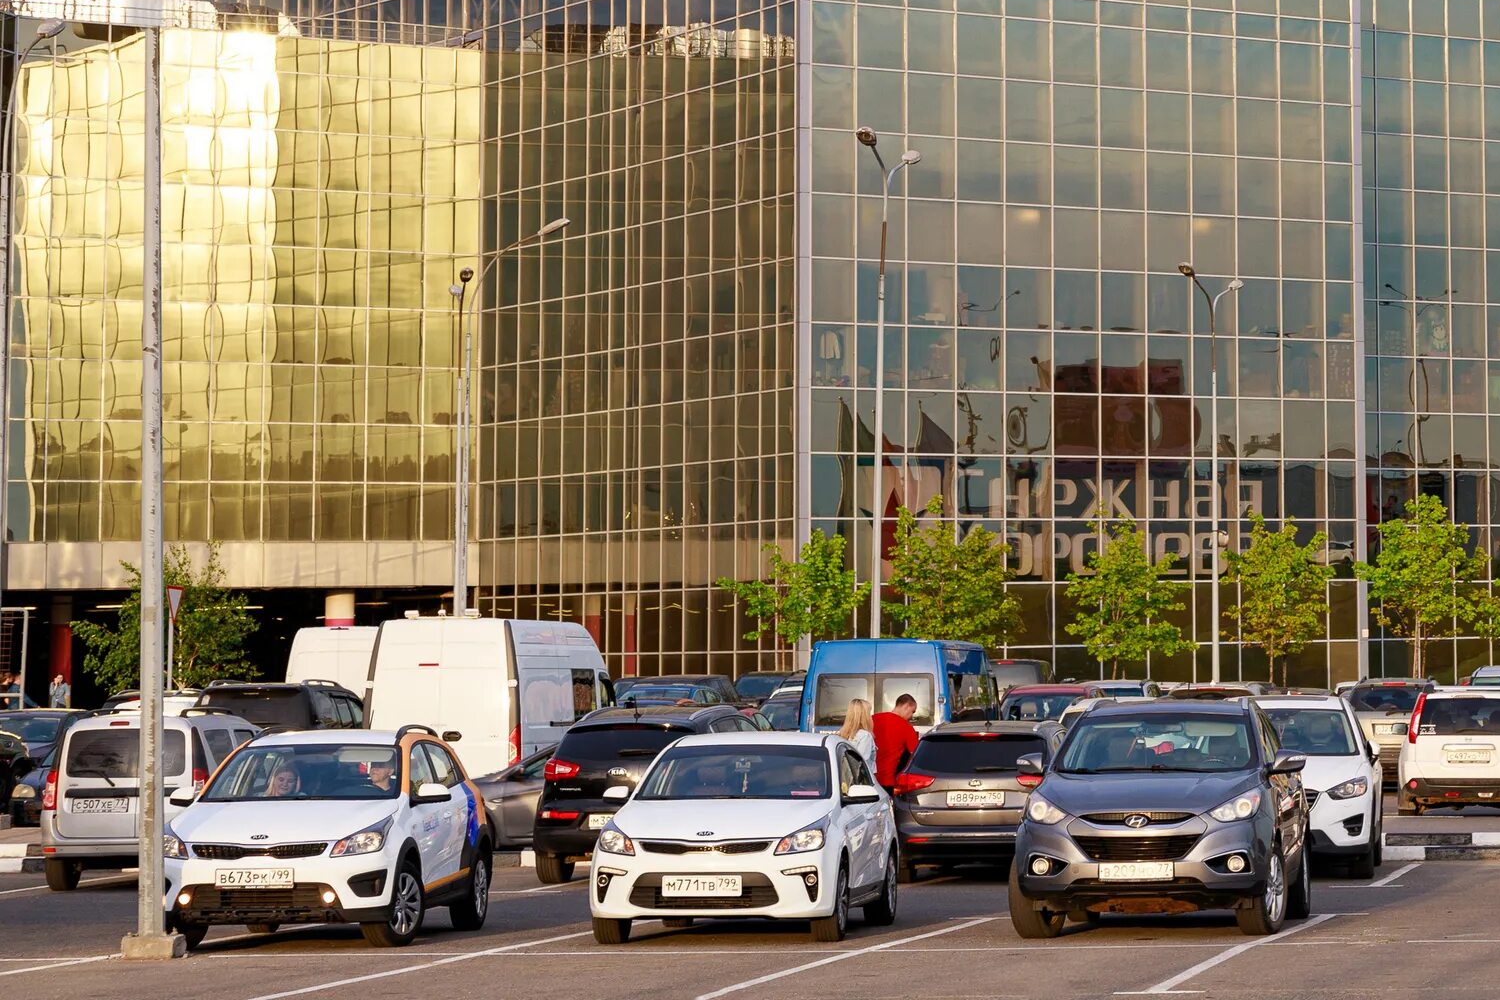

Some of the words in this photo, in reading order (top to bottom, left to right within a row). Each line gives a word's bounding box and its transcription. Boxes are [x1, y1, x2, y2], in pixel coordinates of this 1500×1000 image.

[988, 792, 1002, 800] 750
[115, 798, 125, 807] 77
[220, 871, 268, 884] В673РК
[270, 870, 290, 880] 799
[667, 879, 716, 892] М771ТВ
[718, 878, 738, 888] 799
